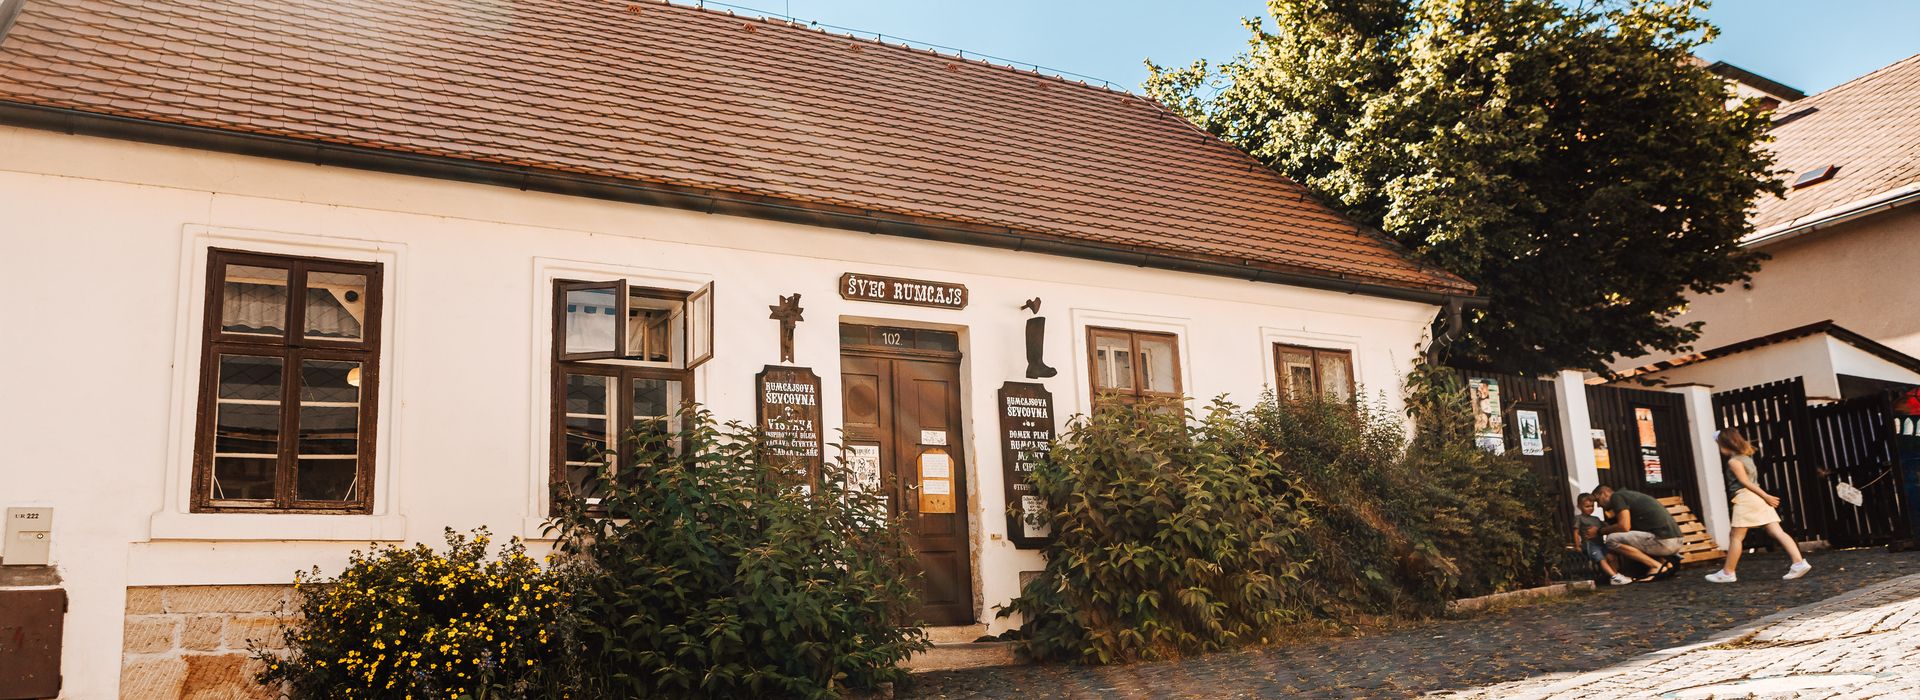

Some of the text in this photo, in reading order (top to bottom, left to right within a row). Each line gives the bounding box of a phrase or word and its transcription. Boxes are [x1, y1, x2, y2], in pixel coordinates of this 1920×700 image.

[848, 275, 962, 305] ŠVEC RUMCAJS
[882, 332, 903, 346] 102.
[765, 382, 815, 393] RUMCAJSOVA
[766, 390, 816, 405] ŠEVCOVNA
[1006, 396, 1047, 407] RUMCAJSOVA
[1007, 404, 1048, 418] ŠEVCOVNA
[768, 415, 813, 431] VÝSAVA
[1009, 429, 1049, 440] DOMEK PLNÝ
[1014, 462, 1020, 472] A
